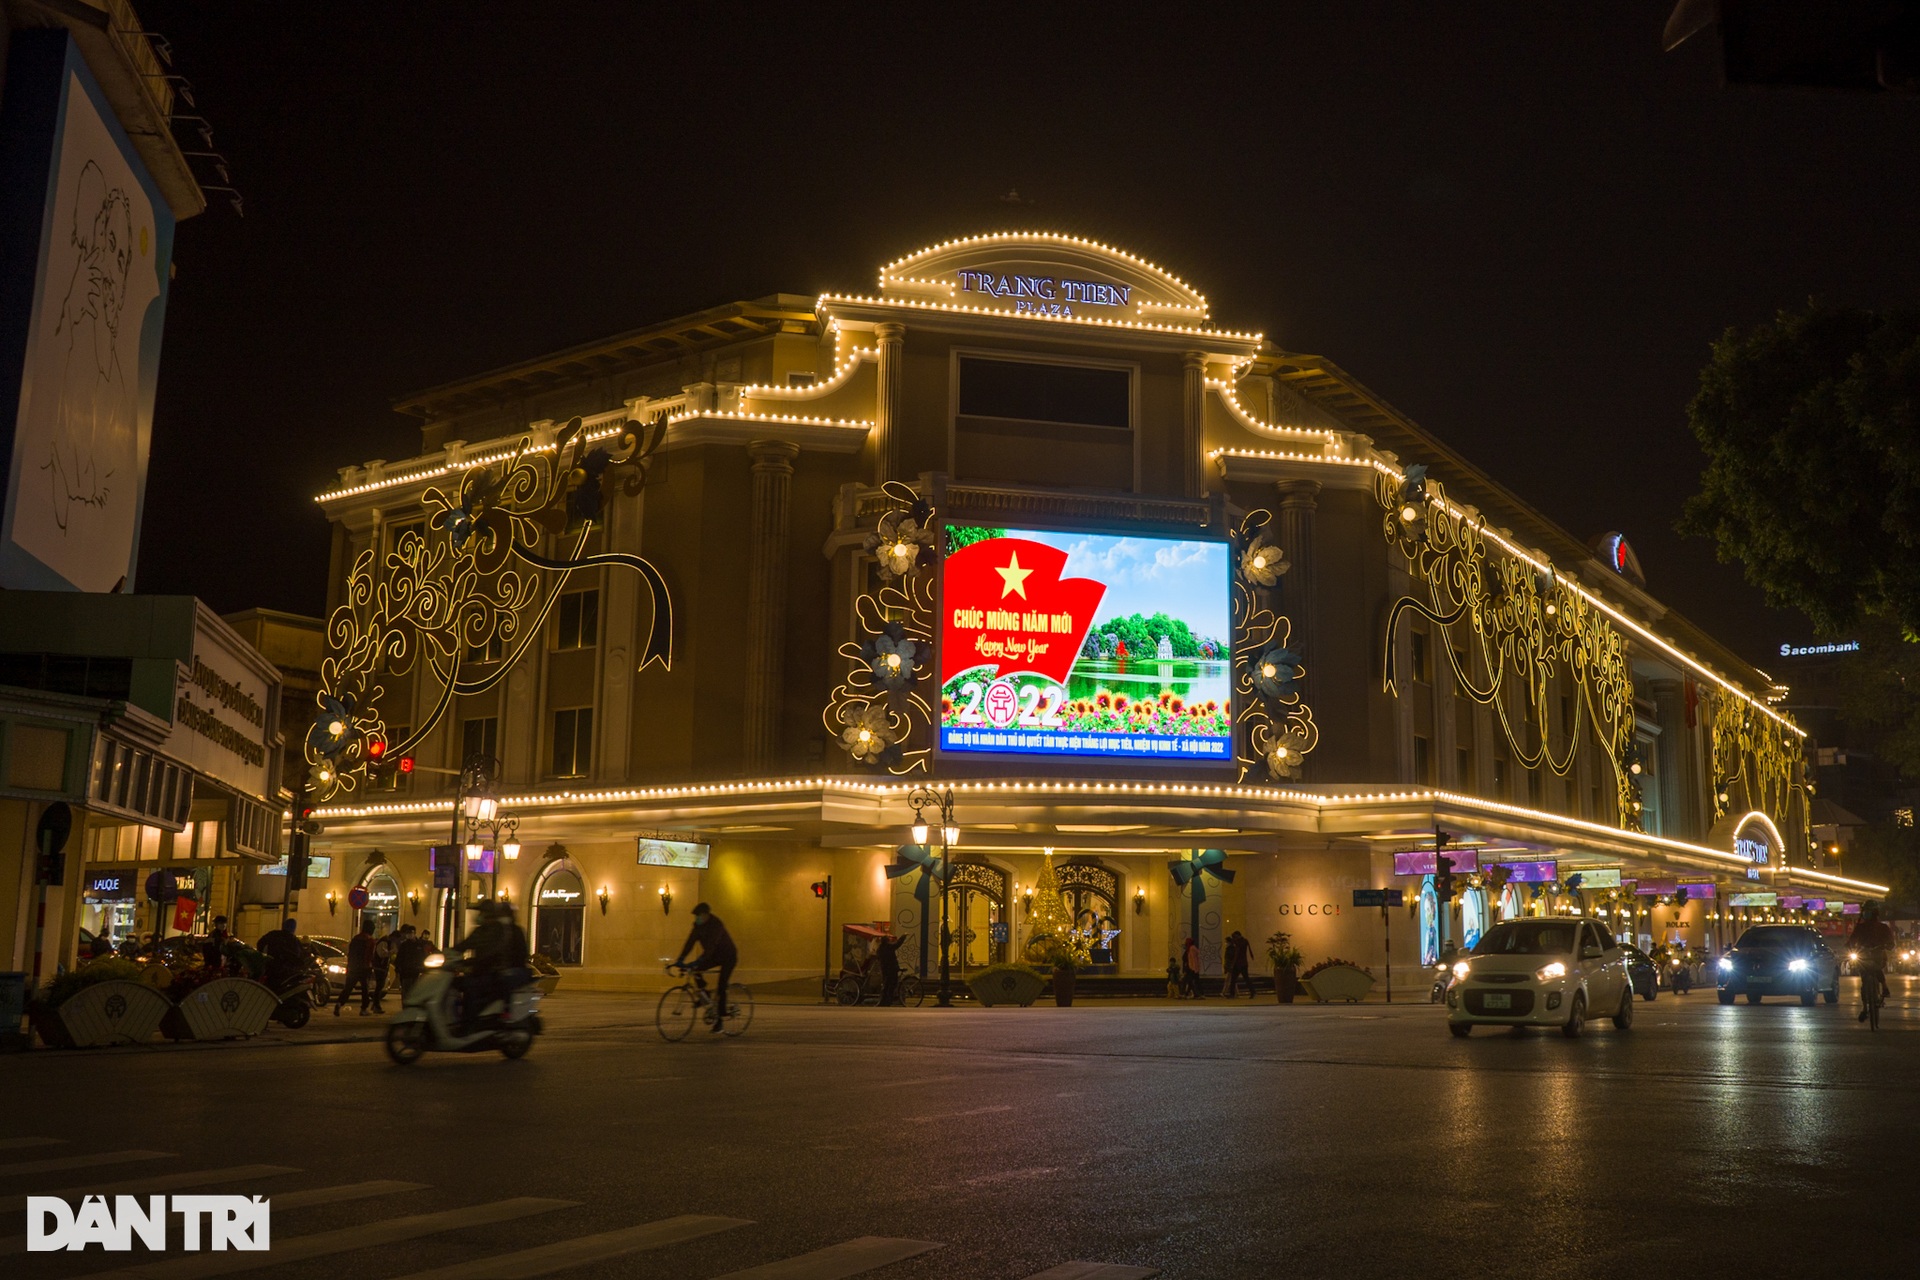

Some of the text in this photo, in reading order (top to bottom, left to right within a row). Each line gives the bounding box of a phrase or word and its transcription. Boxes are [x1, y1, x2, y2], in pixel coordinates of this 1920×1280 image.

[957, 271, 1131, 306] TRANG TIEN
[1016, 300, 1073, 316] PLAZA
[953, 606, 1072, 634] CHÚC MỪNG NĂM MỚI
[975, 633, 1049, 663] Happy New Year
[1780, 640, 1860, 656] Sacombank
[1278, 904, 1340, 915] GUCCI
